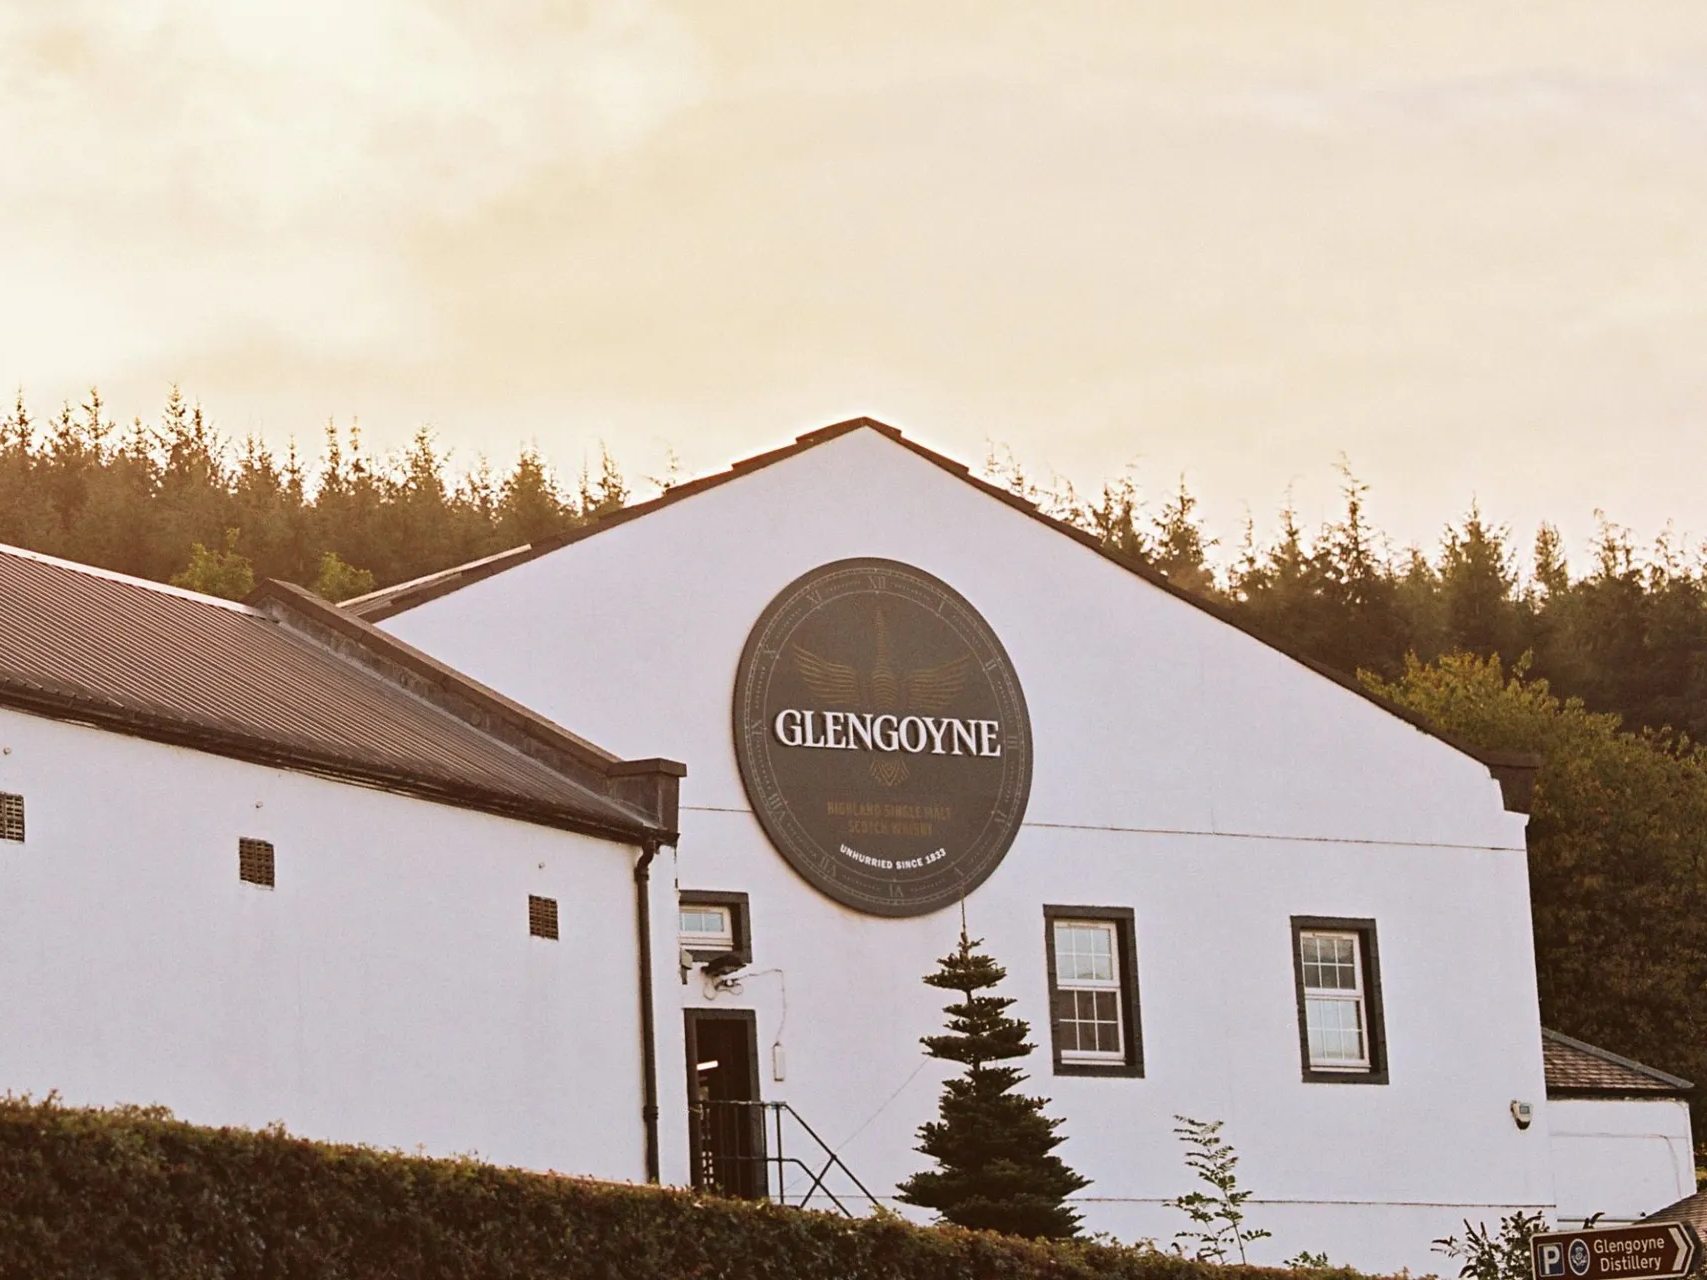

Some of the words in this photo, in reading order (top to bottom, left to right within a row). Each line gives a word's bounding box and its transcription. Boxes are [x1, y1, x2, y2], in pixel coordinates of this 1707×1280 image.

[774, 709, 1001, 757] GLENGOYNE
[826, 801, 883, 818] HIGHLAND
[883, 803, 924, 820] SINGLE
[847, 819, 890, 834] SCOTCH
[891, 822, 934, 838] WHISKY
[839, 843, 894, 870] UNHURRIED
[895, 857, 925, 870] SINCE
[924, 847, 948, 866] 1833
[1593, 1236, 1665, 1255] Glengoyne
[1545, 1245, 1560, 1274] P
[1600, 1255, 1662, 1272] Distillery
